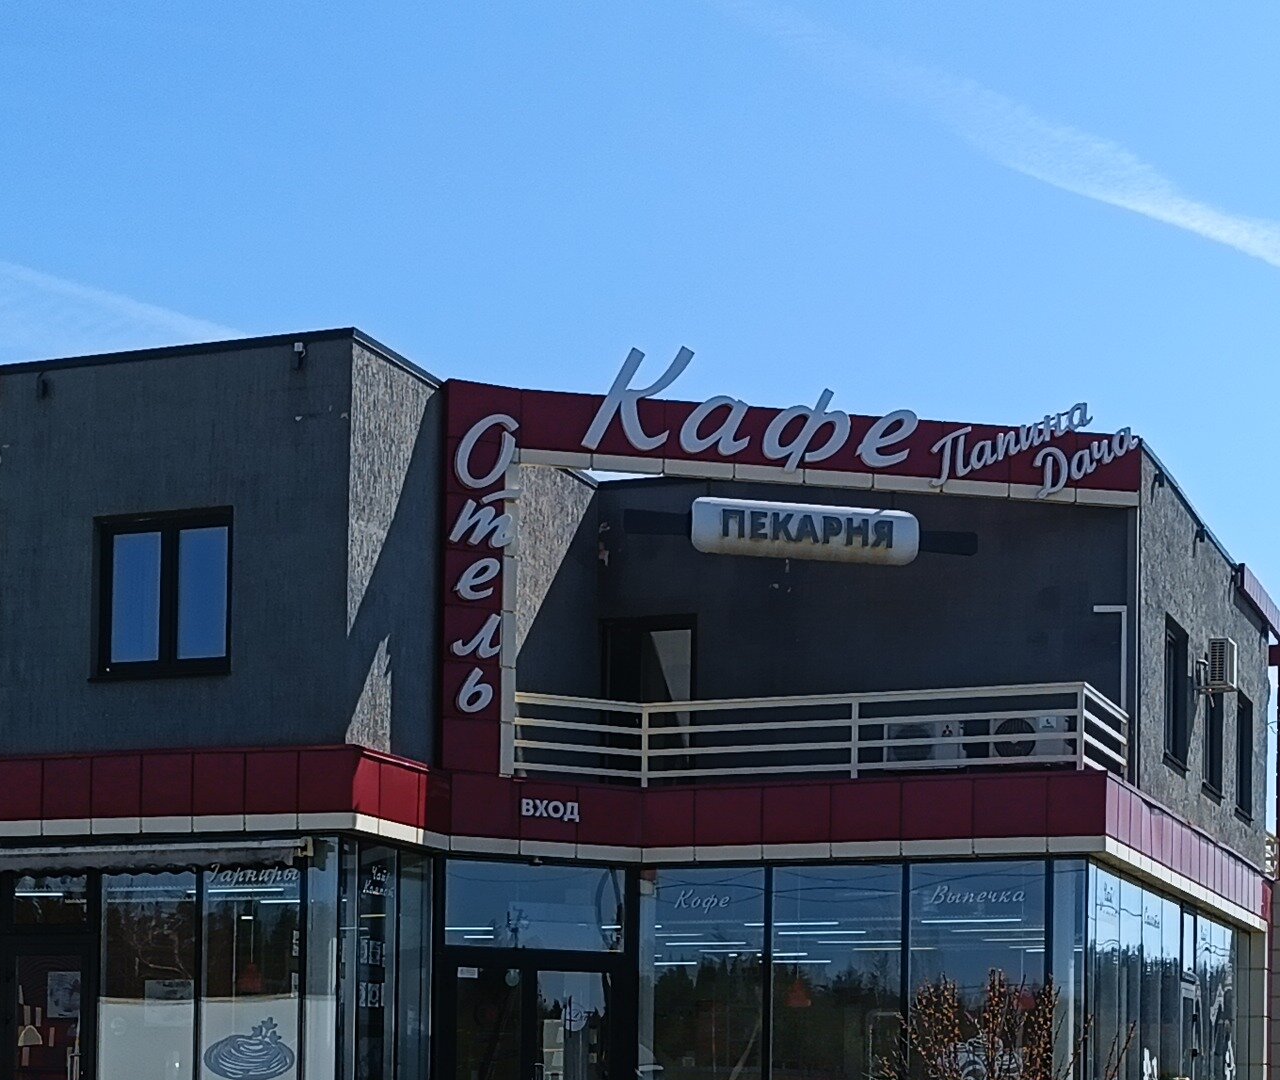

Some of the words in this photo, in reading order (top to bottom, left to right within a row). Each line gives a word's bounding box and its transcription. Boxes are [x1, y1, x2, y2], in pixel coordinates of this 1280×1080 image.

[580, 345, 919, 473] Кафе
[929, 402, 1094, 489] Папина
[1033, 422, 1140, 499] Дача
[720, 508, 895, 550] ПЕКАРНЯ
[449, 413, 520, 713] Отель
[521, 798, 580, 823] ВХОД
[207, 864, 300, 887] Гарниры
[930, 885, 1025, 906] Выпечка
[674, 889, 731, 914] Кофе
